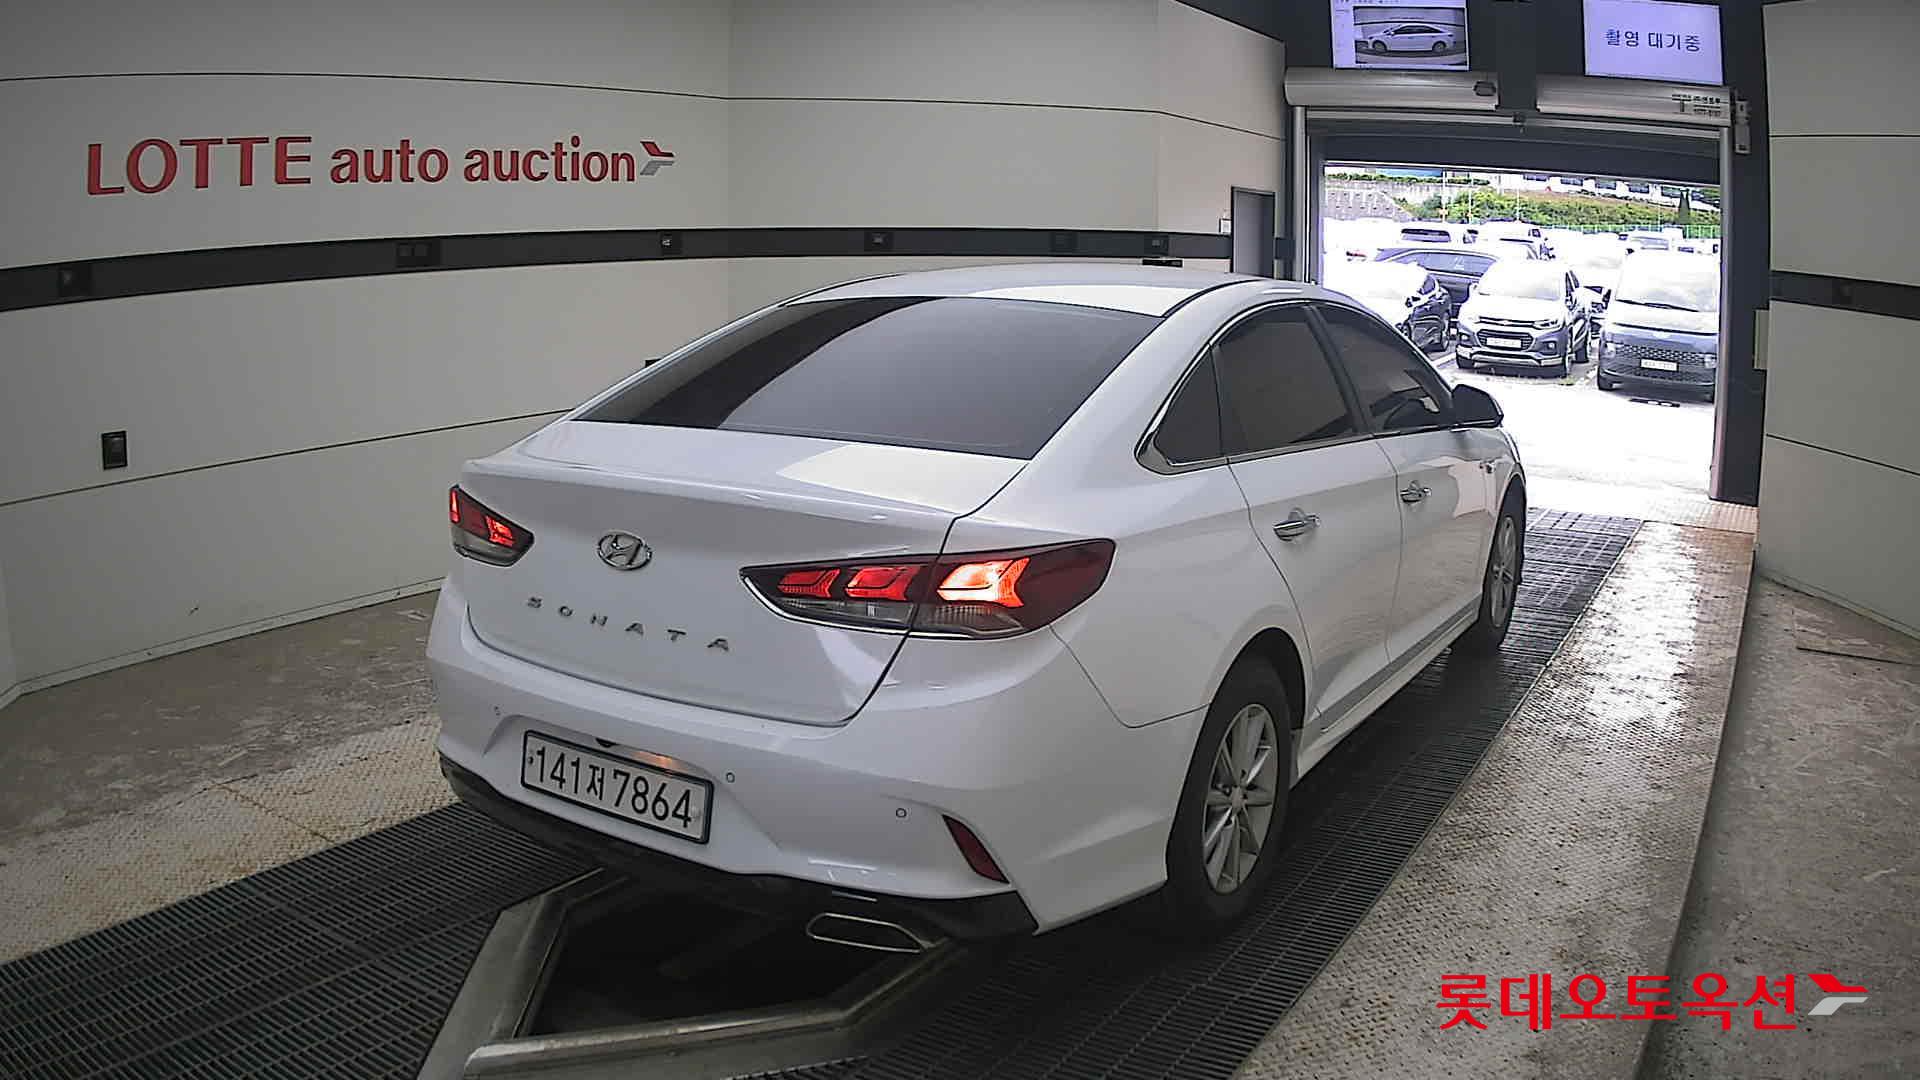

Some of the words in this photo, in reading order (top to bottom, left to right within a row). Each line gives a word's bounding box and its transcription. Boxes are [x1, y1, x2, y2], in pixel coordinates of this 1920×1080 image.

[1648, 32, 1701, 52] 대기중
[87, 135, 313, 196] LOTTE
[330, 138, 449, 184] auto
[463, 134, 636, 183] auction
[527, 597, 730, 652] SONATA
